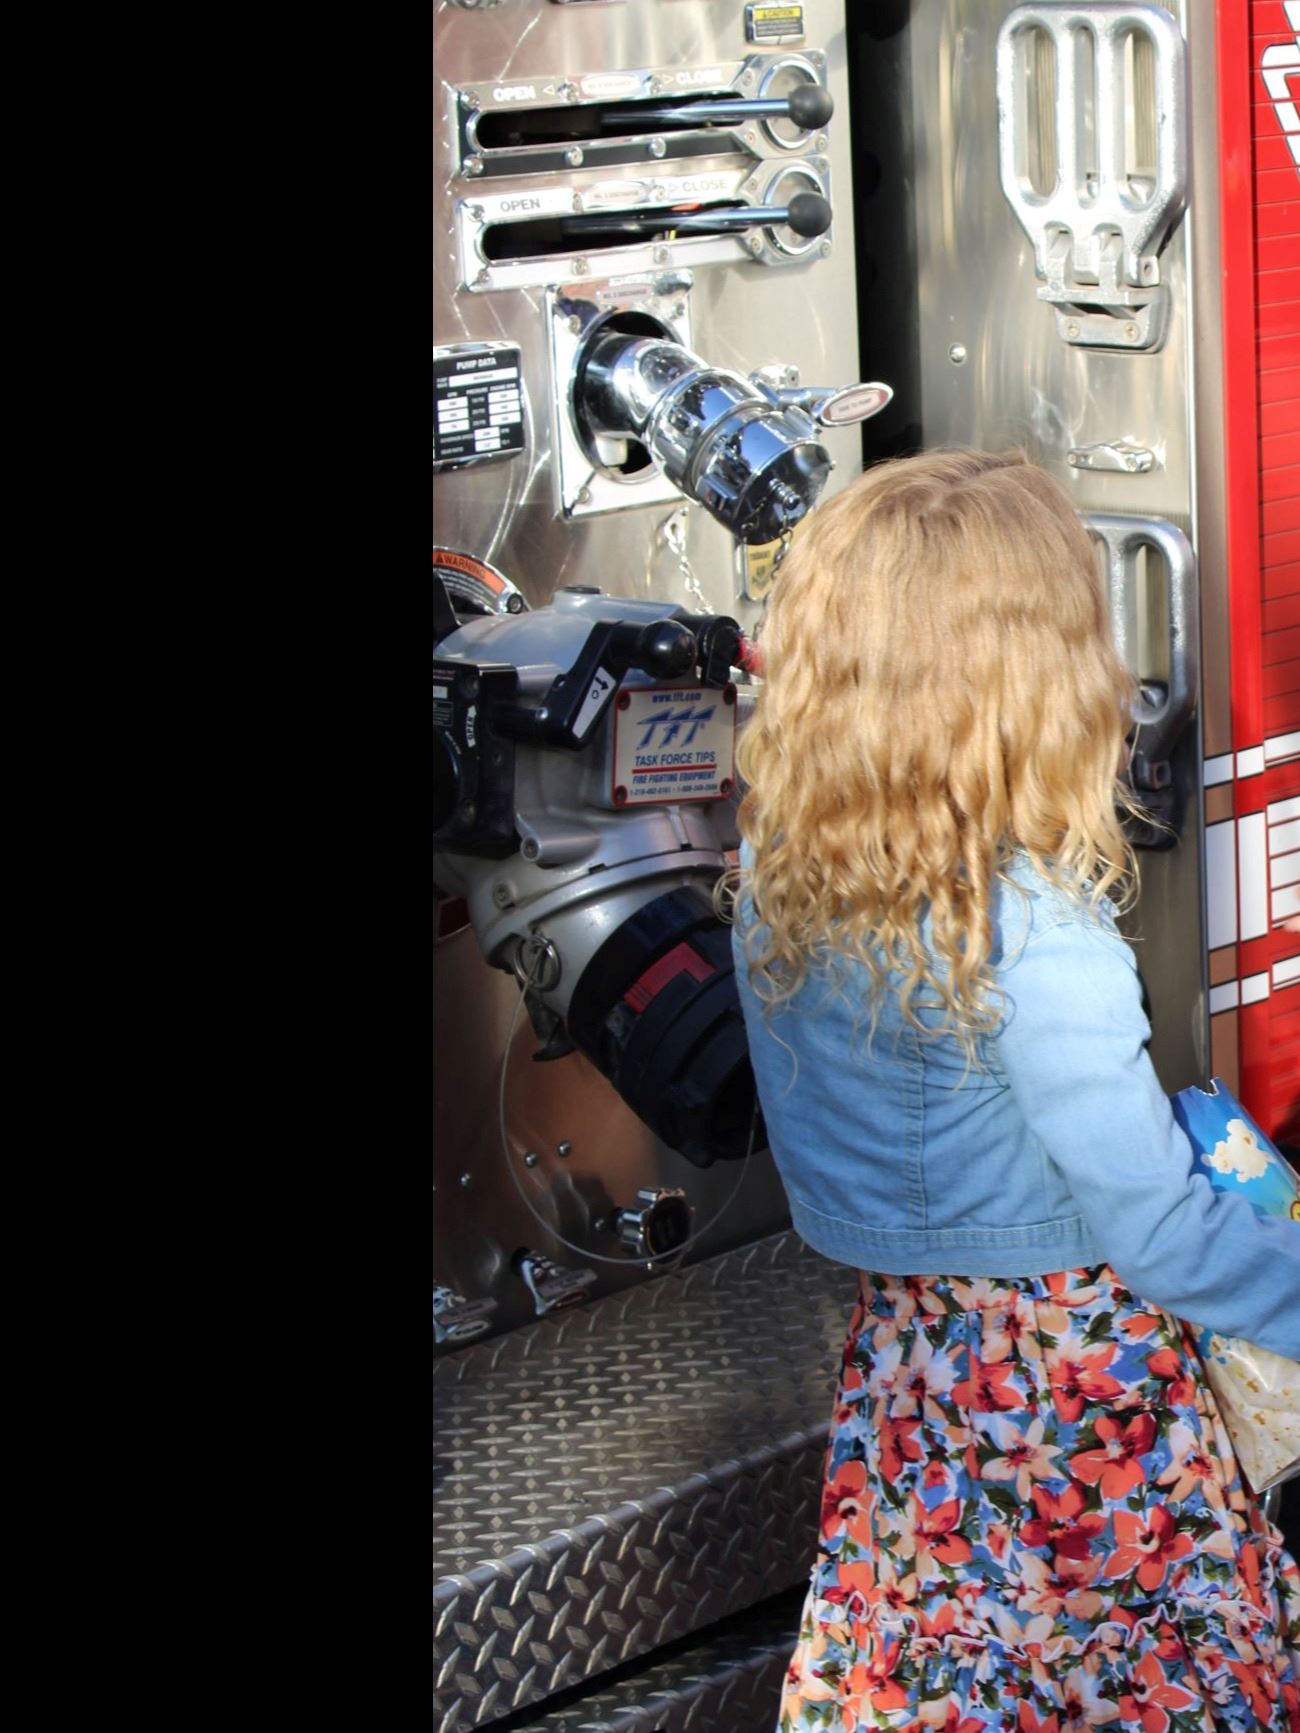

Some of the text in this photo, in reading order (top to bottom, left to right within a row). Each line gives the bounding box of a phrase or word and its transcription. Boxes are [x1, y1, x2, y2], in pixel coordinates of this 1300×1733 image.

[493, 85, 537, 101] OPEN
[682, 179, 728, 192] CLOSE
[500, 197, 541, 212] OPEN
[456, 359, 477, 370] PUMP
[441, 552, 487, 580] WARNING
[635, 751, 716, 767] TASK FORCE TIPS
[633, 774, 648, 784] FIRE
